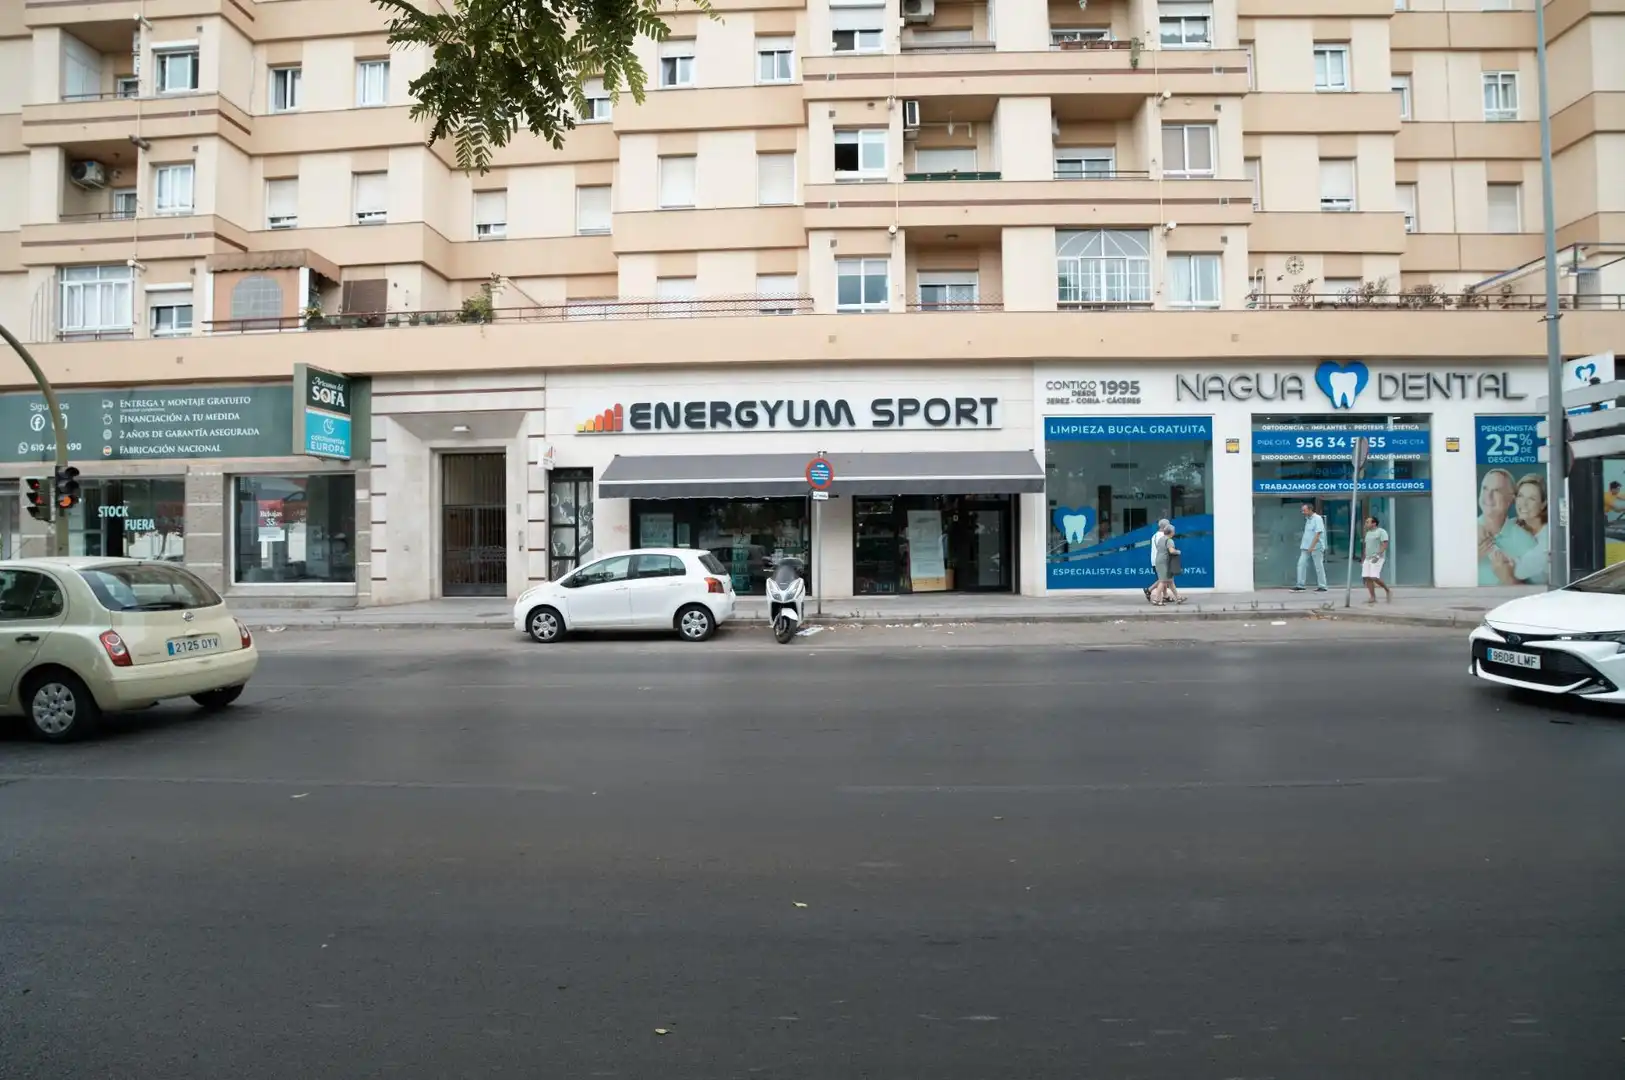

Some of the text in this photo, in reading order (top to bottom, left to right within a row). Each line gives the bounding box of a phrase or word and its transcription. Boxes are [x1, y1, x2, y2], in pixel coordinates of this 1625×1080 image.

[1046, 380, 1140, 395] CONTIGO 1995
[1176, 372, 1528, 401] NAGUA DENTAL
[120, 399, 158, 408] ENTREGA
[168, 398, 205, 406] MONTAJE
[207, 396, 251, 405] GRATUITO
[120, 413, 182, 424] FINANCIACIÓN
[205, 412, 240, 421] MEDIDA
[630, 398, 998, 430] ENERGYUM SPORT
[119, 428, 260, 439] 2 AÑOS DE GARANTÍA ASEGURADA
[1050, 425, 1206, 434] LIMPIEZA BUCAL GRATUITA
[311, 441, 345, 453] EUROPA
[1296, 437, 1324, 448] 956
[1328, 437, 1346, 448] 34
[1369, 437, 1386, 447] 55
[120, 444, 221, 454] FABRICACIÓN NACIONAL
[98, 506, 128, 517] STOCK
[125, 519, 155, 530] FUERA
[1053, 568, 1122, 576] ESPECIALISTAS
[176, 640, 199, 652] 2125
[1493, 651, 1537, 666] 9608 LMF
